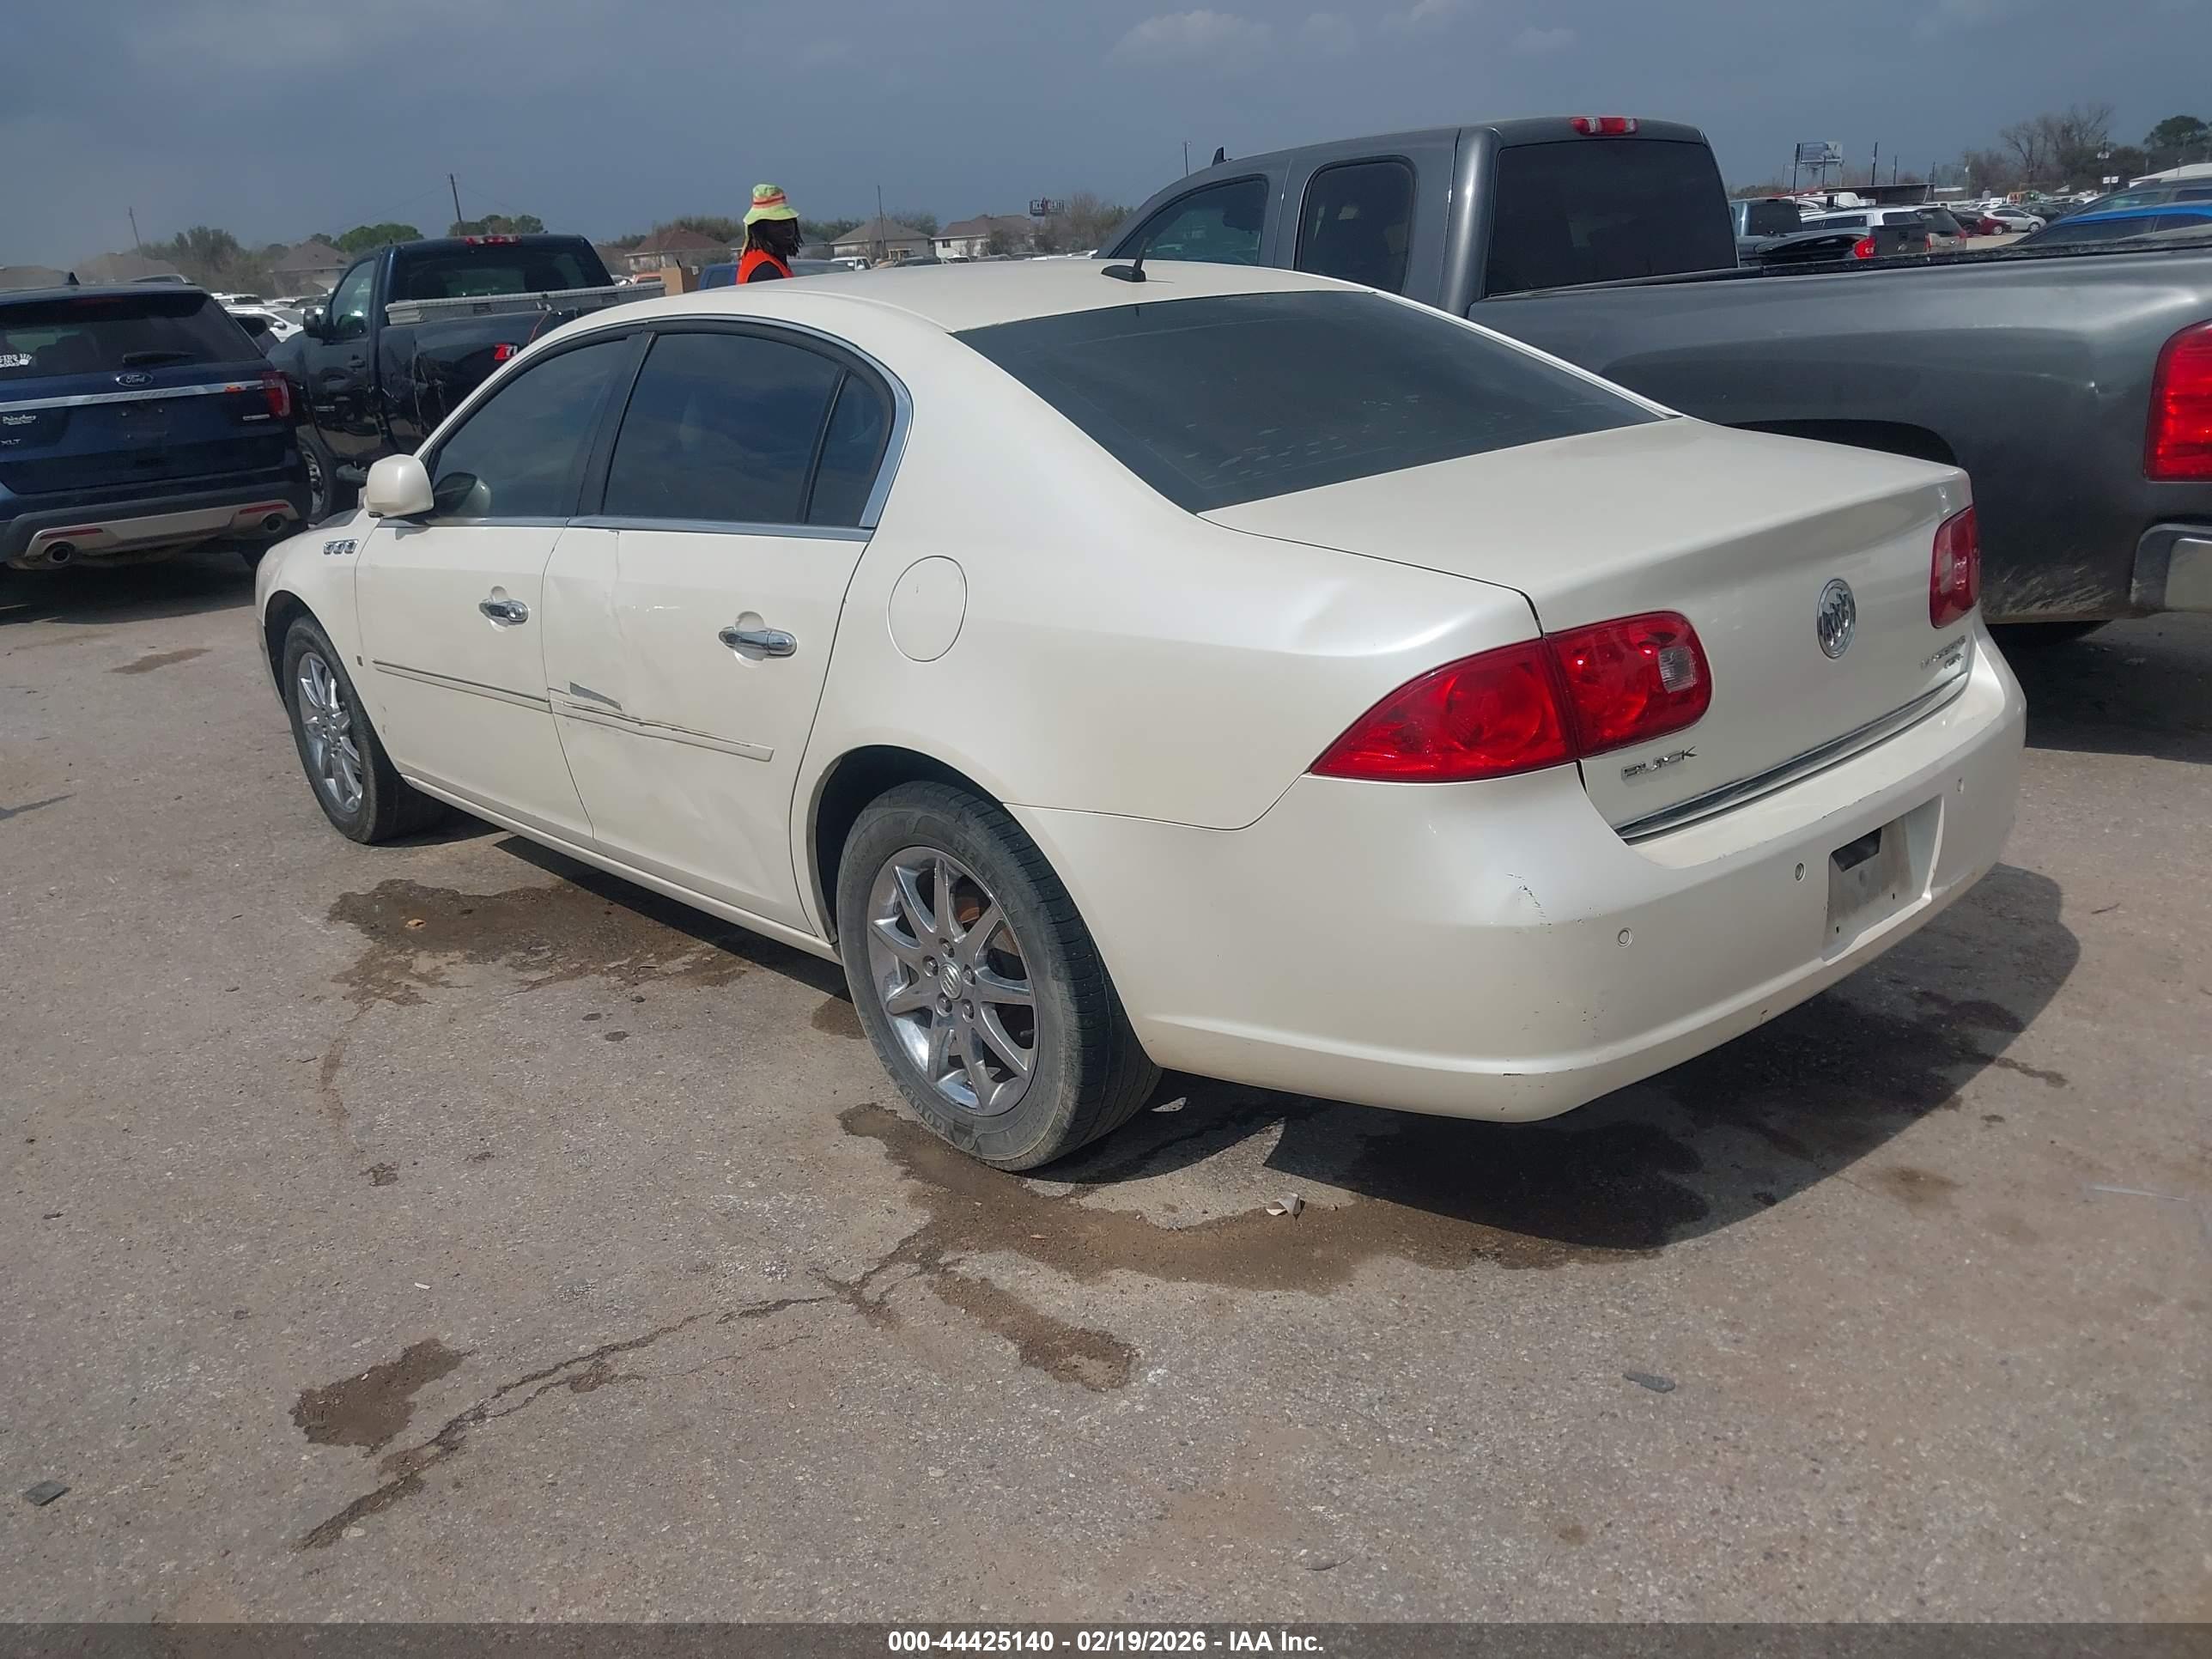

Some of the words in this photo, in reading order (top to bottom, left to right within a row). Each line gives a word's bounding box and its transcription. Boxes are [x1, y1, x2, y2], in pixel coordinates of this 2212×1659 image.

[495, 343, 519, 361] Z71
[126, 374, 145, 384] Ford
[1621, 745, 1698, 780] BUICK
